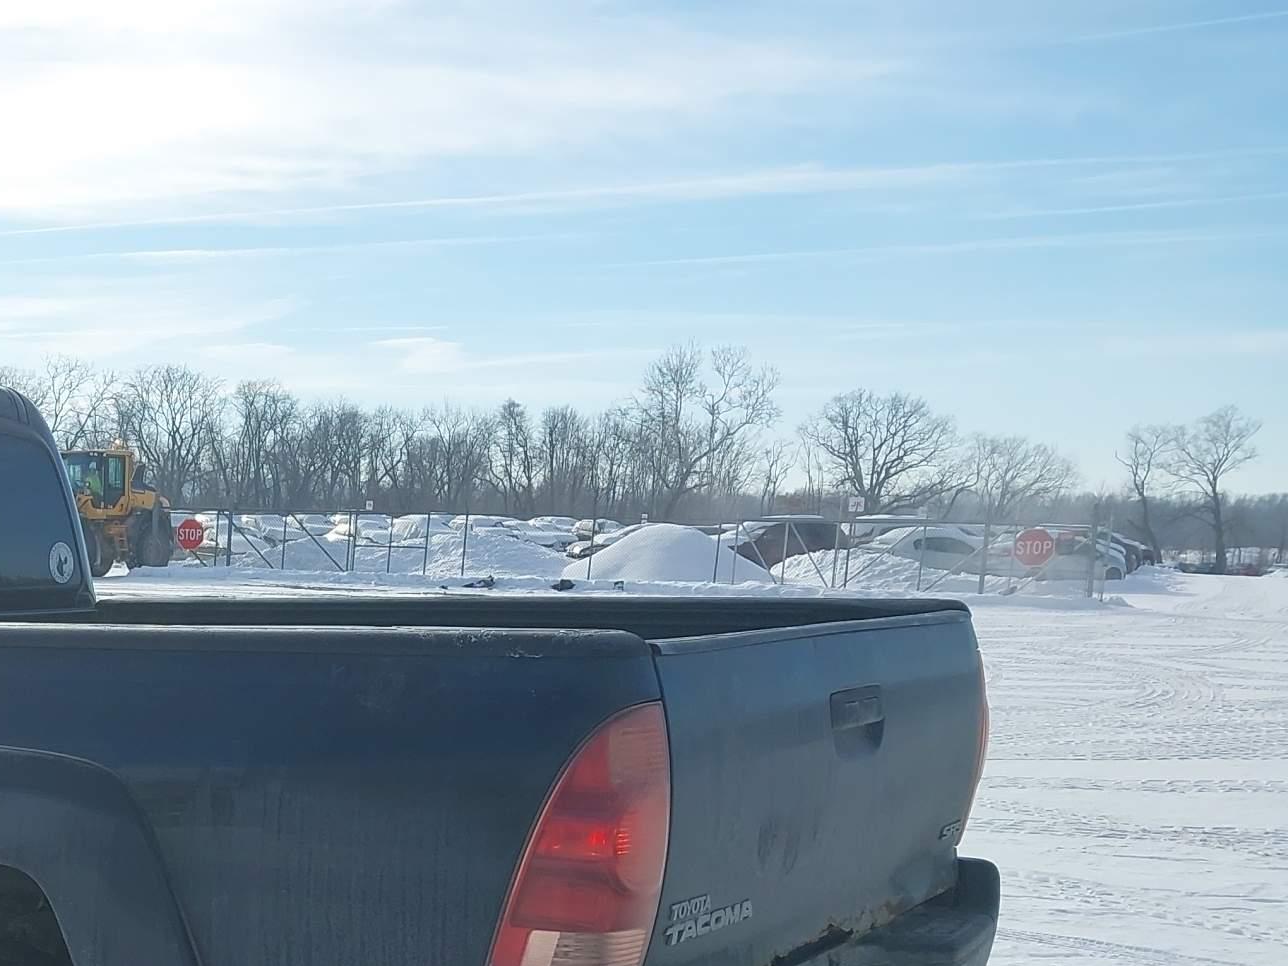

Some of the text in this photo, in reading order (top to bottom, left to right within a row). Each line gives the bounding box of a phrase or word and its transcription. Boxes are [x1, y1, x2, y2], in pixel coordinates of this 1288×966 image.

[178, 528, 202, 541] STOP
[1015, 540, 1052, 555] STOP
[671, 894, 712, 921] TOYOTA
[665, 899, 753, 946] TACOMA
